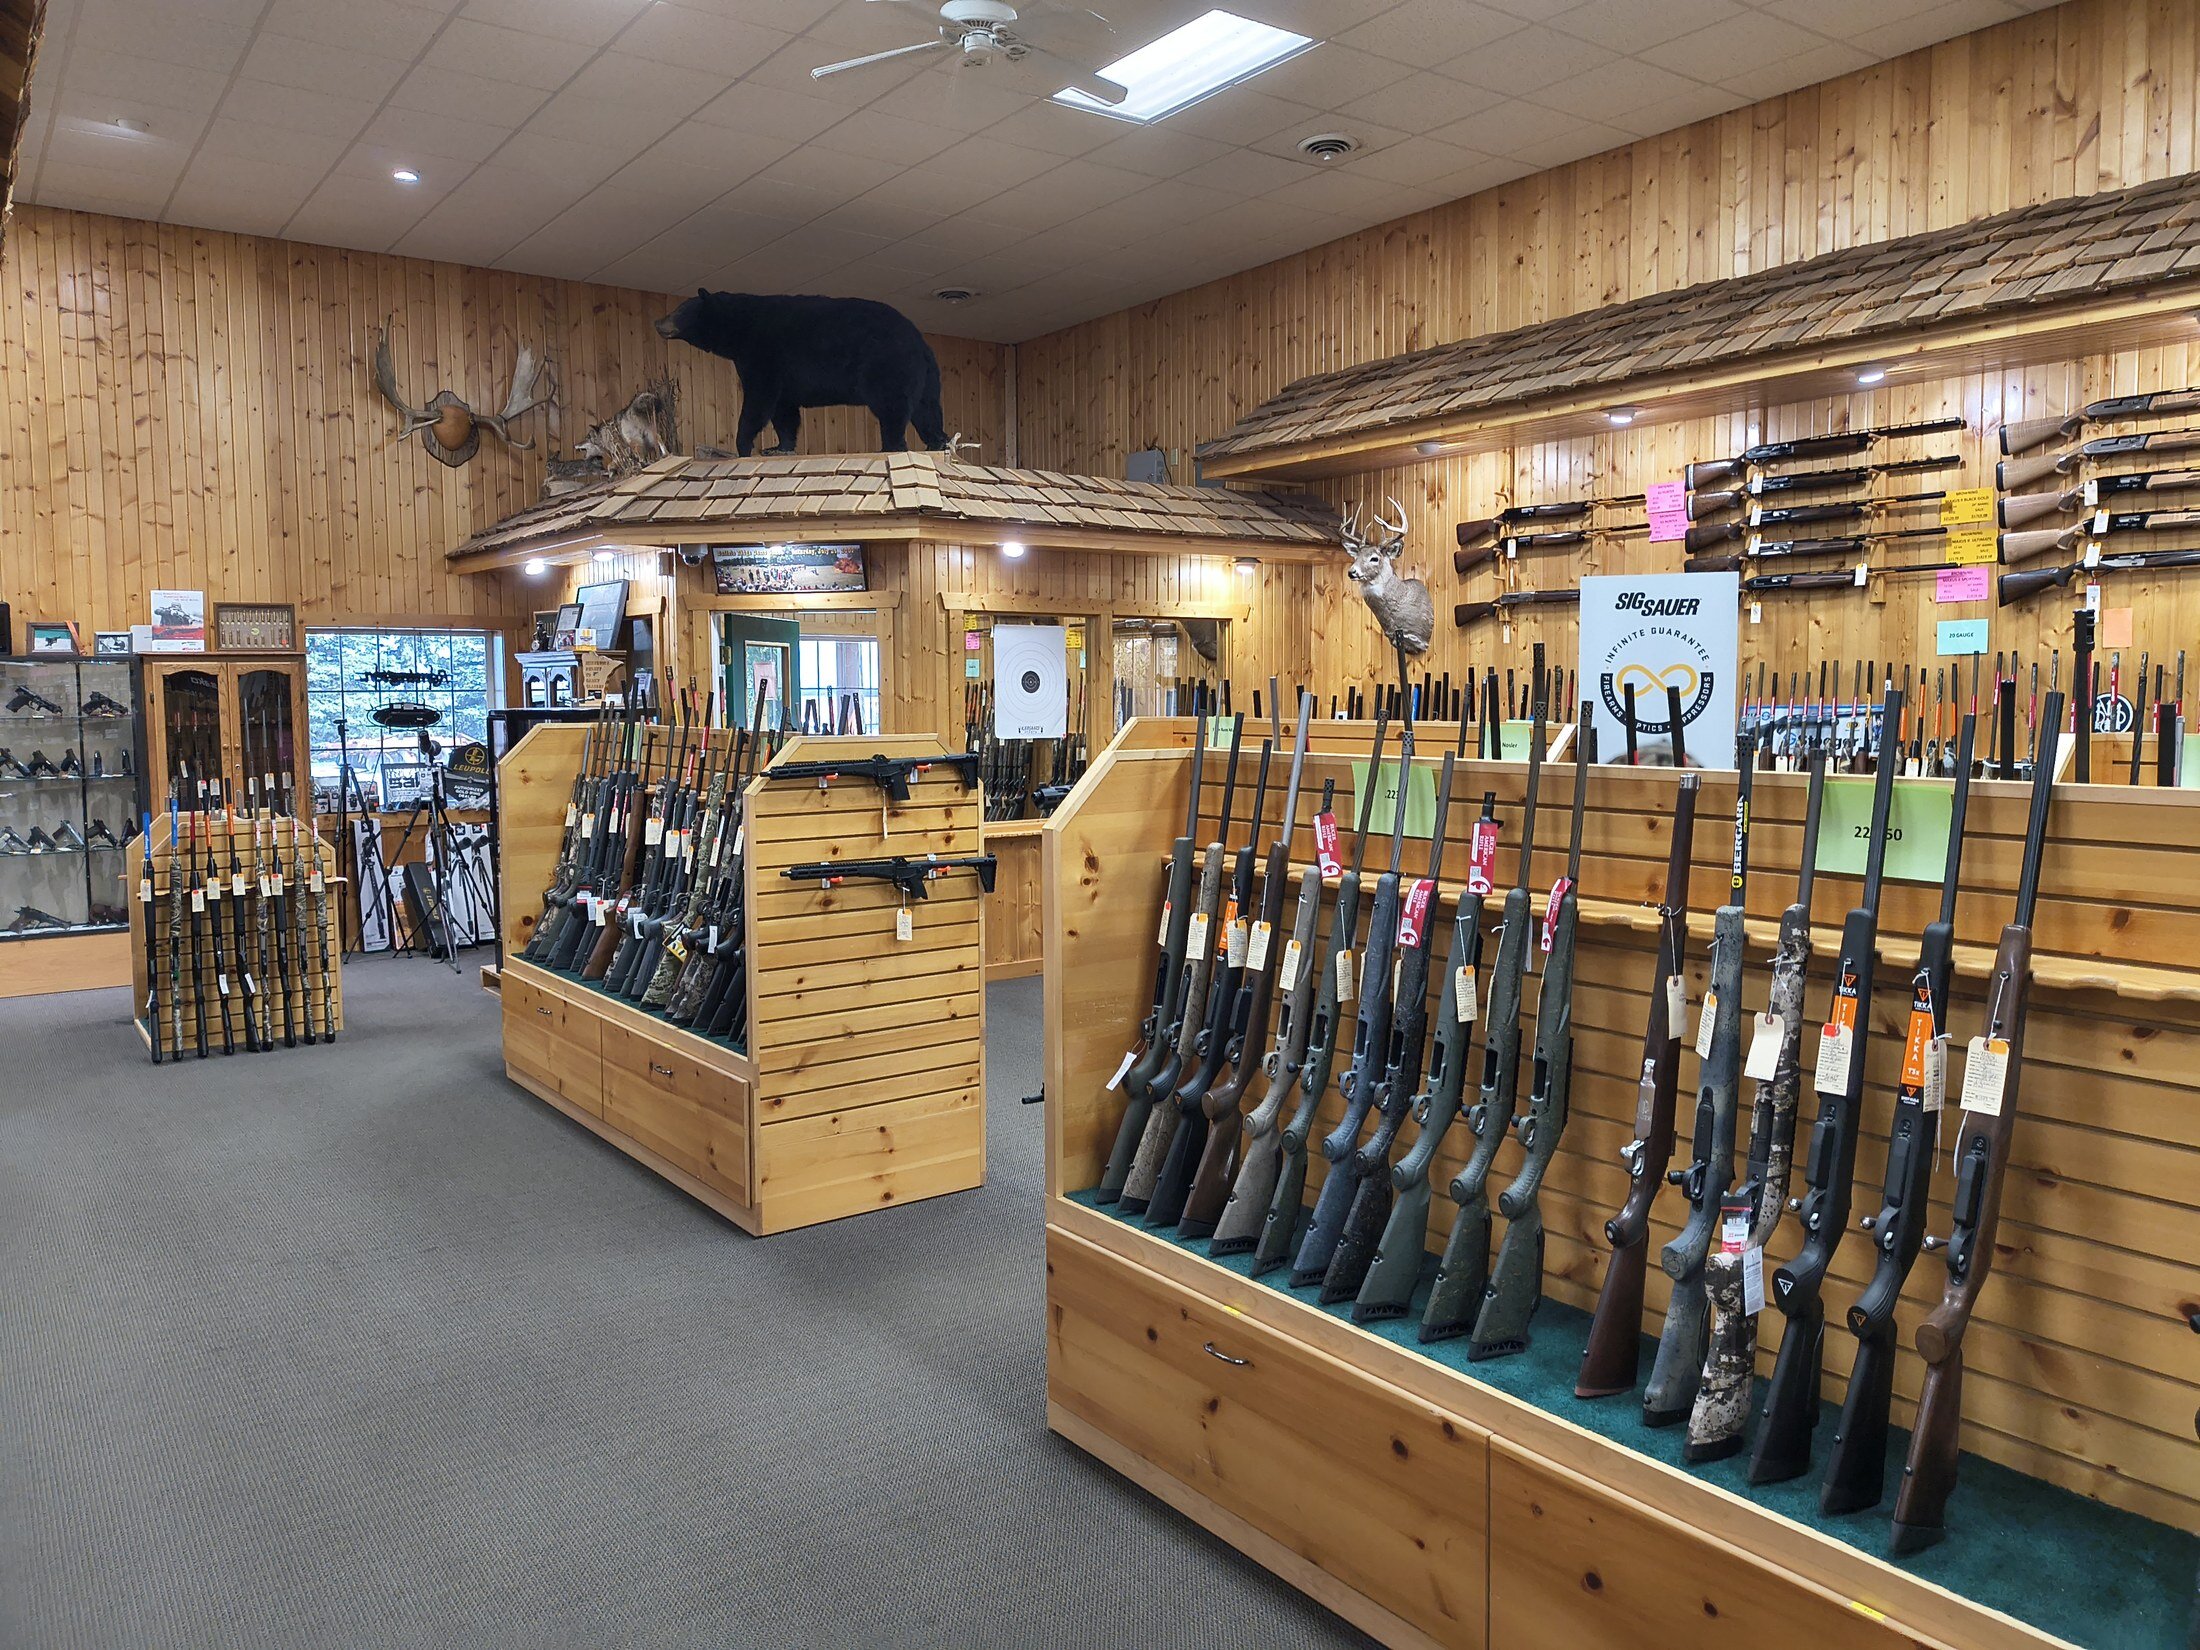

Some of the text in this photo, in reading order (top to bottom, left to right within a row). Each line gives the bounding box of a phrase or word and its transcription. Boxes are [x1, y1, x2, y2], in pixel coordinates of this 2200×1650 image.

[1615, 592, 1701, 617] SIG SAUER
[1604, 627, 1710, 664] INFINITE GUARANTEE
[1602, 675, 1711, 732] FIREARMS PTICS PPRESSORS
[1325, 824, 1334, 852] AMERICAN
[1482, 835, 1490, 866] AMERICAN
[1413, 889, 1424, 919] AMERICAN
[1840, 1003, 1848, 1026] TIK
[1913, 1000, 1931, 1009] TIKKA
[1911, 1019, 1922, 1062] TIKKA
